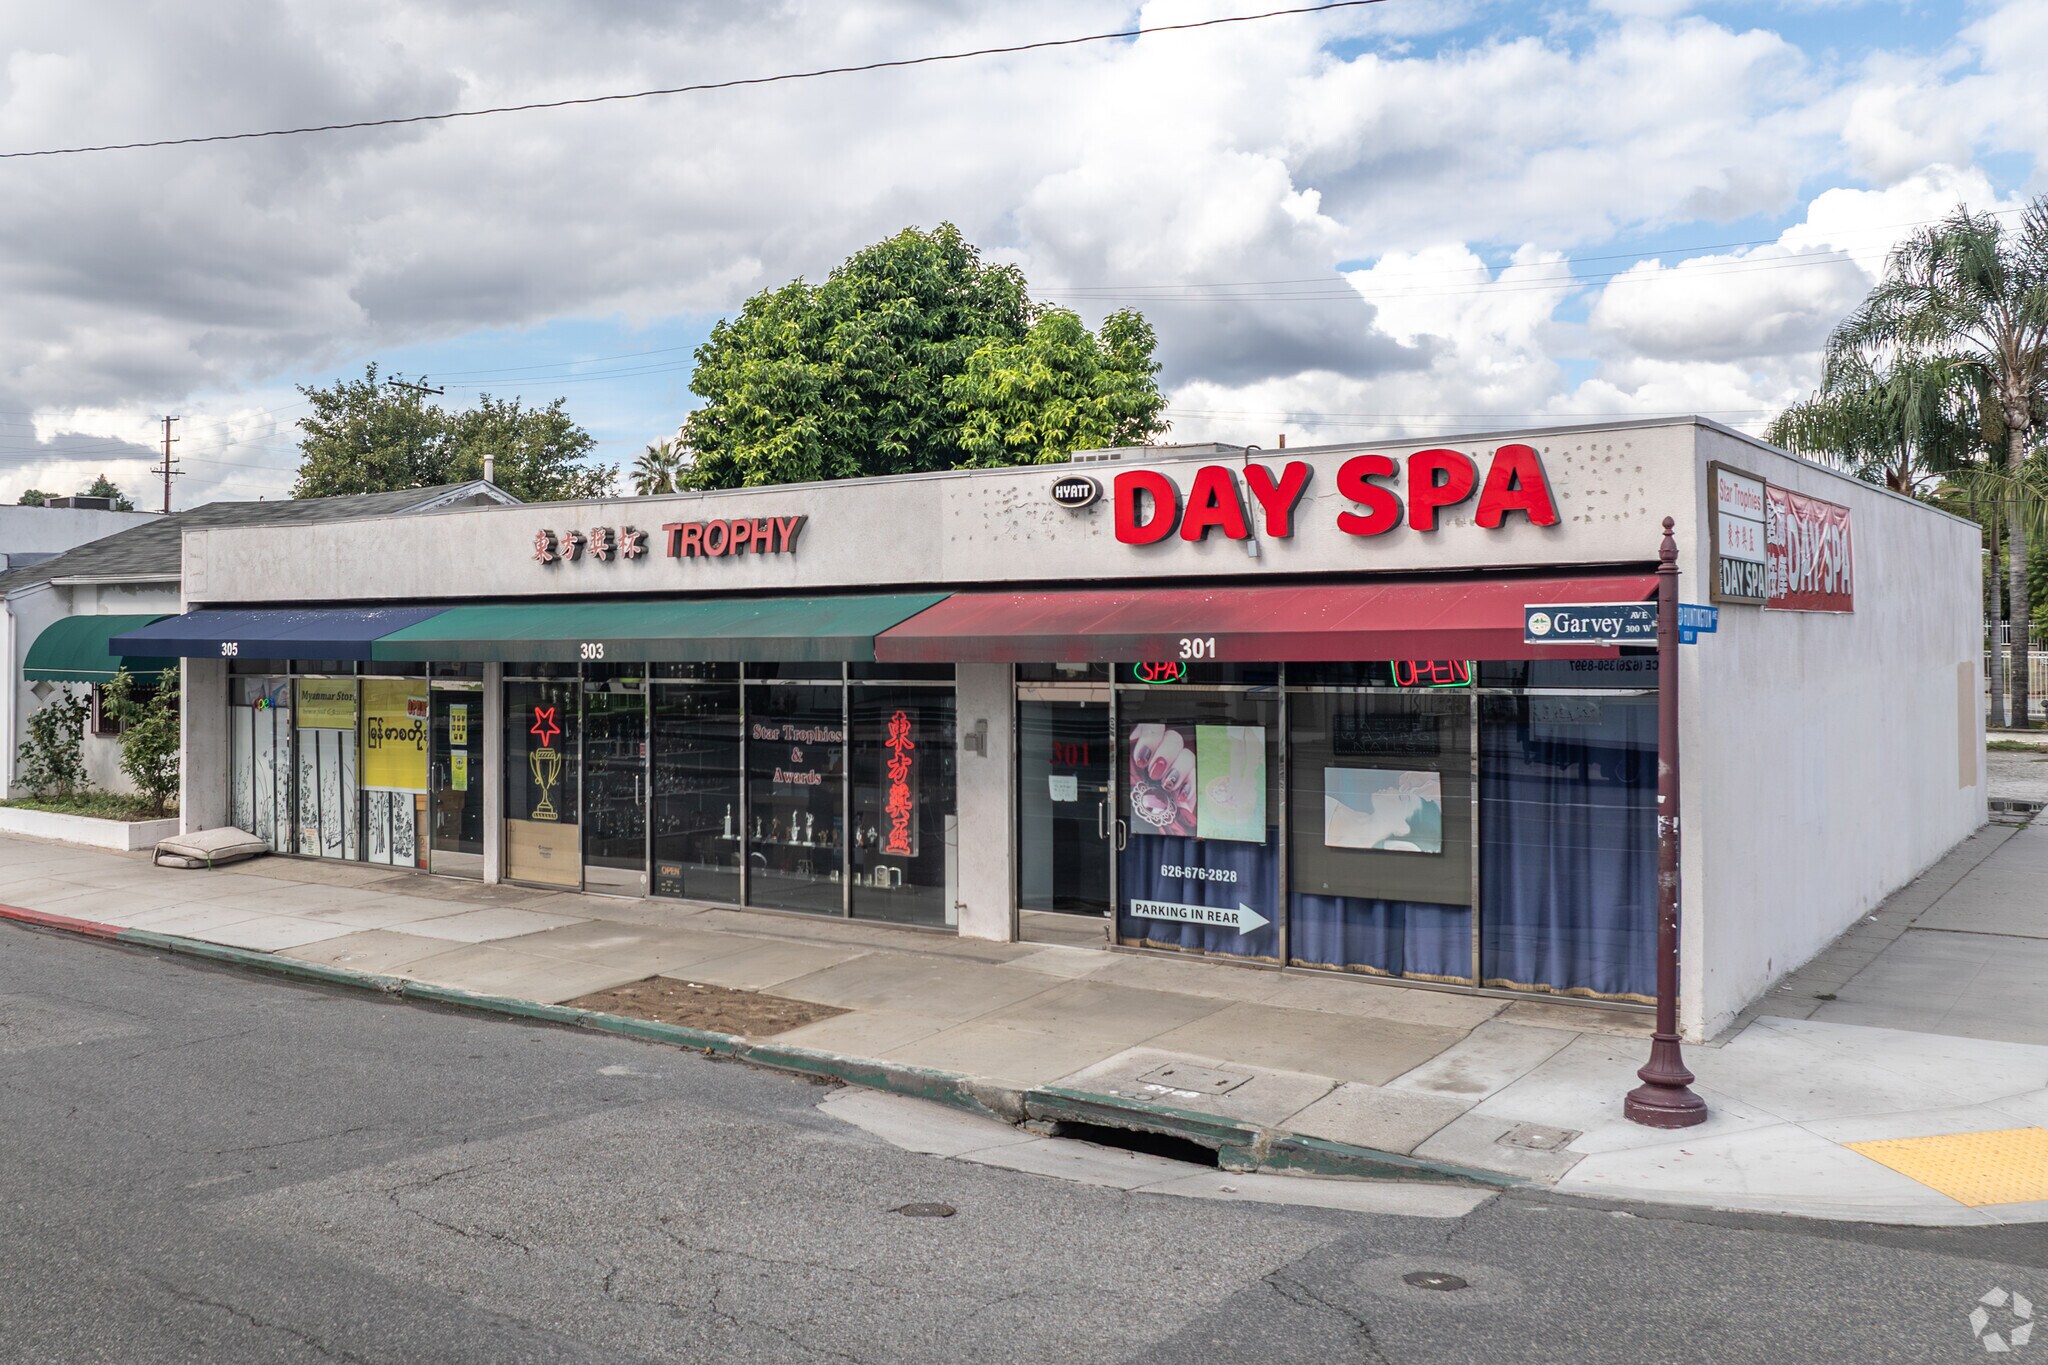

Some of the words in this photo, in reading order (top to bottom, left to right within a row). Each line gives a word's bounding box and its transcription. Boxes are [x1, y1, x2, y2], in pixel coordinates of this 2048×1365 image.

[1055, 483, 1090, 499] HYATT
[1114, 460, 1311, 546] DAY
[1336, 444, 1560, 537] SPA
[1720, 478, 1733, 502] Star
[1734, 483, 1762, 512] Trophies
[662, 515, 806, 558] TROPHY
[1786, 513, 1819, 592] DAY
[1823, 521, 1852, 596] SPA
[1723, 558, 1744, 596] DAY
[1746, 562, 1766, 598] SPA
[1554, 612, 1624, 638] Garvey
[1630, 611, 1648, 619] AVE
[1625, 624, 1640, 633] 300
[1643, 624, 1652, 633] W
[221, 642, 238, 656] 305
[580, 642, 605, 660] 303
[1179, 637, 1216, 659] 301
[1142, 661, 1179, 681] SPA
[1394, 660, 1470, 686] OPEN
[302, 690, 336, 703] Myanmar
[753, 724, 780, 740] Star
[783, 724, 843, 743] Trophies
[791, 747, 803, 762] &
[1049, 741, 1090, 767] 301
[773, 768, 822, 785] Awards
[661, 865, 680, 876] OPEN
[1160, 864, 1238, 883] 626-676-2828
[1135, 903, 1188, 919] PARKING
[1191, 909, 1204, 920] IN
[1207, 911, 1239, 924] REAR
